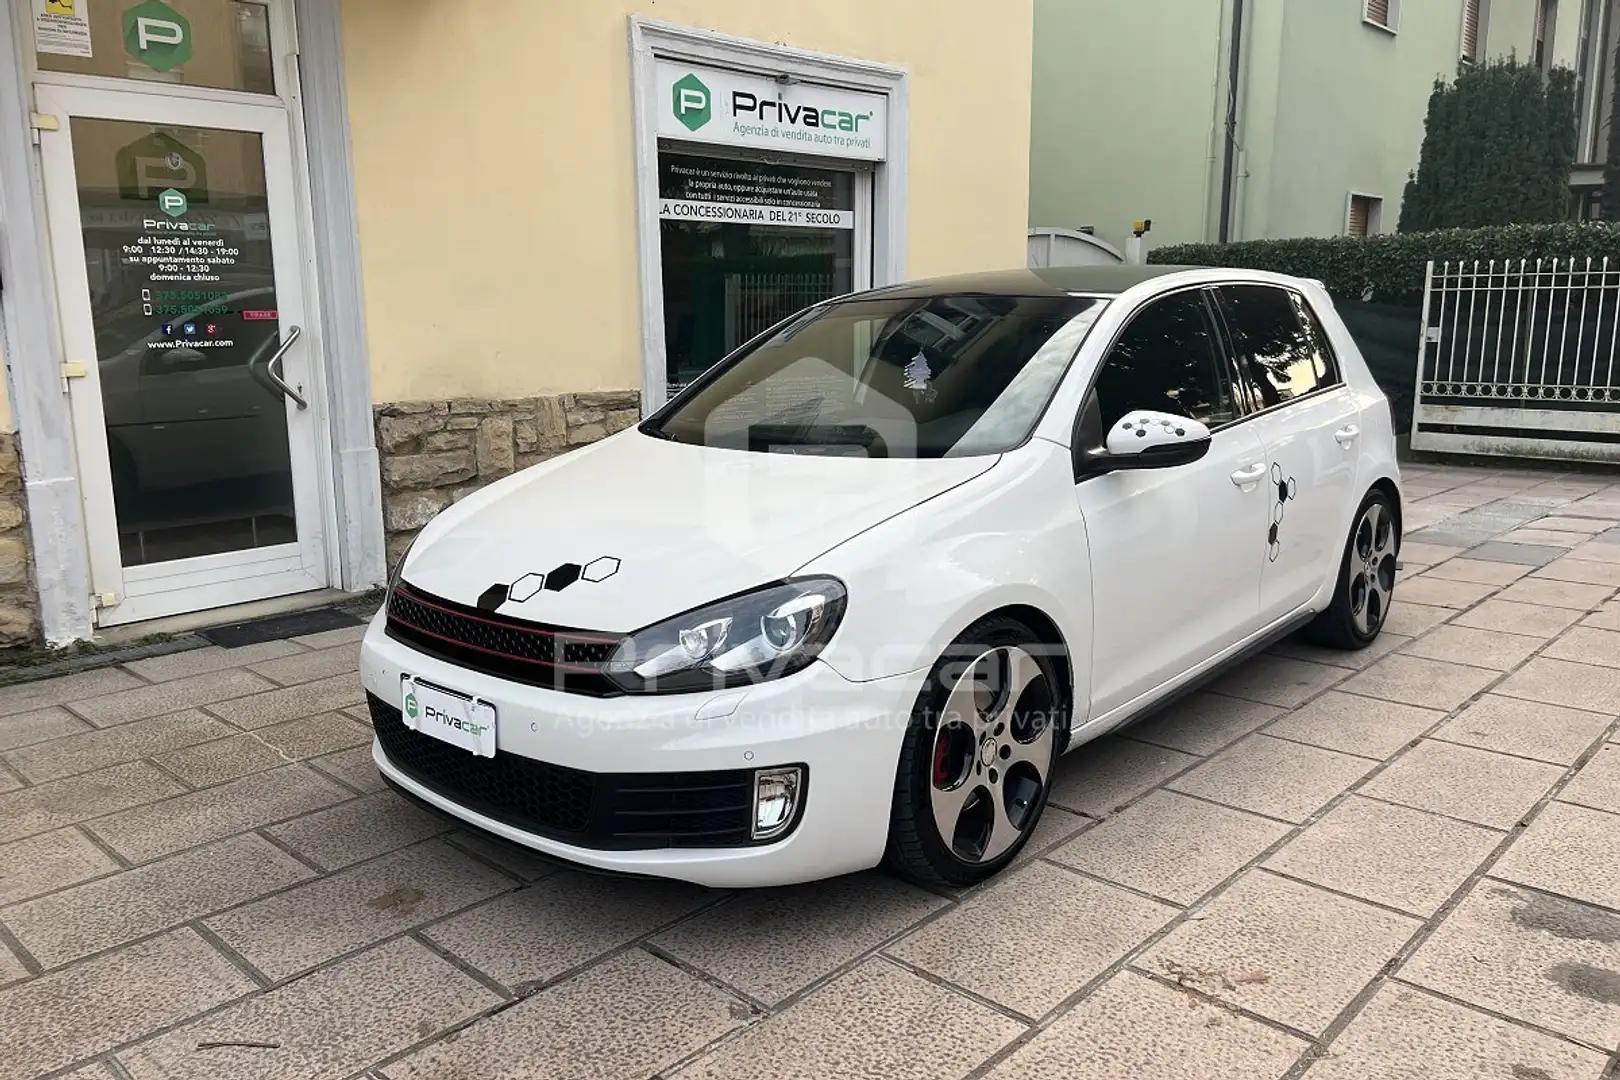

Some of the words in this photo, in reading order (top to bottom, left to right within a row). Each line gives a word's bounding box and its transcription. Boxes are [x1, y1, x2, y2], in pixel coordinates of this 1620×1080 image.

[138, 16, 184, 50] P
[680, 88, 706, 115] P
[732, 90, 871, 132] Privacar
[732, 121, 770, 139] Agenzia
[770, 126, 780, 138] di
[781, 128, 812, 142] vendita
[813, 132, 832, 144] auto
[834, 134, 845, 146] tra
[846, 135, 871, 149] privati
[164, 196, 183, 209] P
[674, 204, 764, 220] CONCESSIONARIA
[770, 211, 786, 221] DEL
[806, 212, 840, 224] SECOLO
[143, 219, 215, 231] Privacar
[142, 256, 205, 264] appuntamento
[207, 256, 235, 264] sabato
[158, 264, 178, 272] 9:00
[150, 272, 191, 281] domenica
[194, 273, 220, 281] chiuso
[147, 339, 234, 349] www.Privacar.com
[425, 706, 488, 736] Privacar
